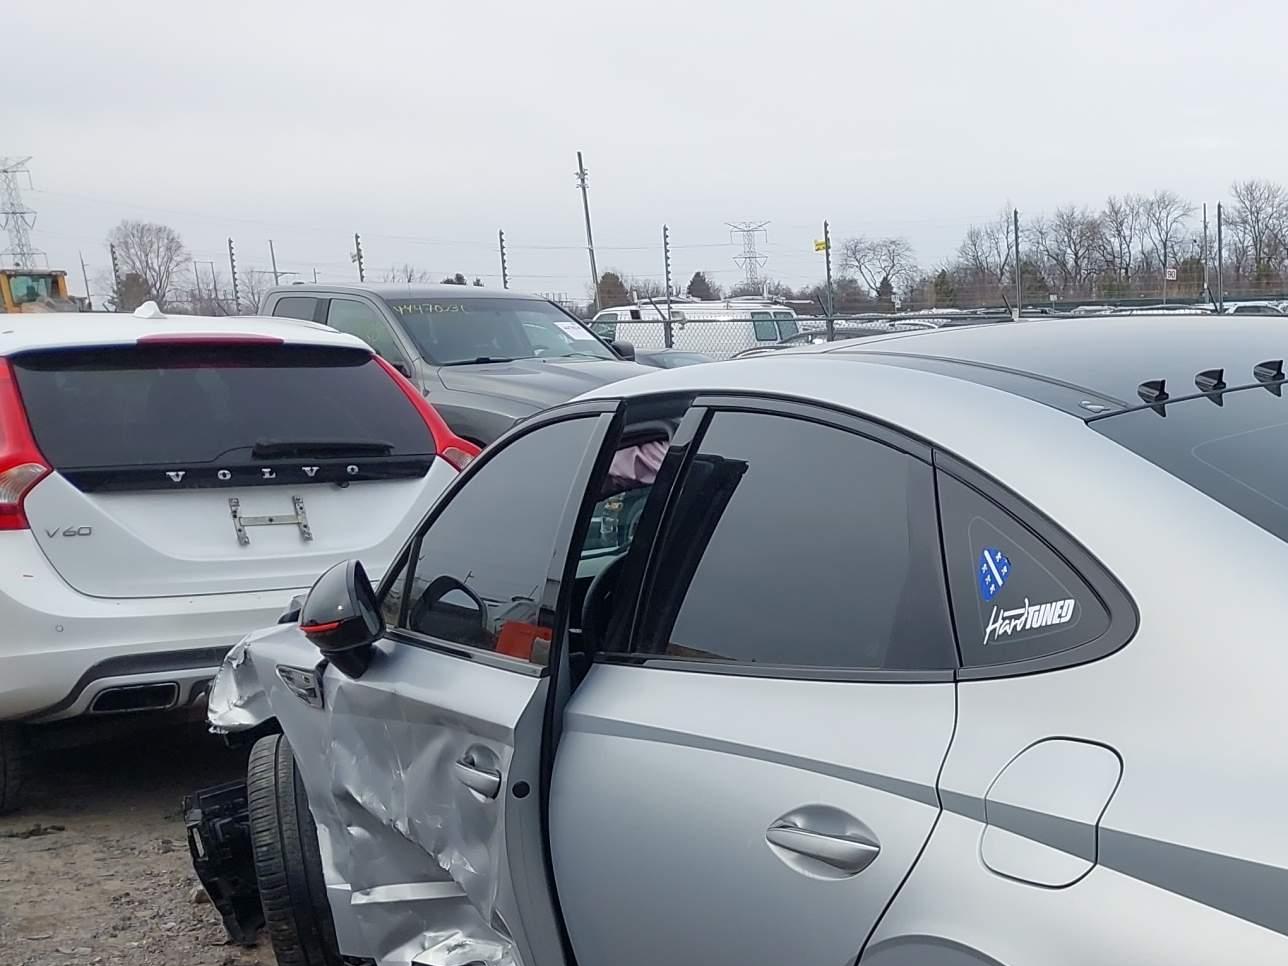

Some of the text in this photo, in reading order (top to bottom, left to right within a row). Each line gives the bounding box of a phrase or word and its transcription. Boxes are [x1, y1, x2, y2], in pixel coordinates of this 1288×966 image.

[1167, 270, 1176, 279] 90
[165, 464, 360, 483] VOLVO
[45, 526, 92, 538] V60
